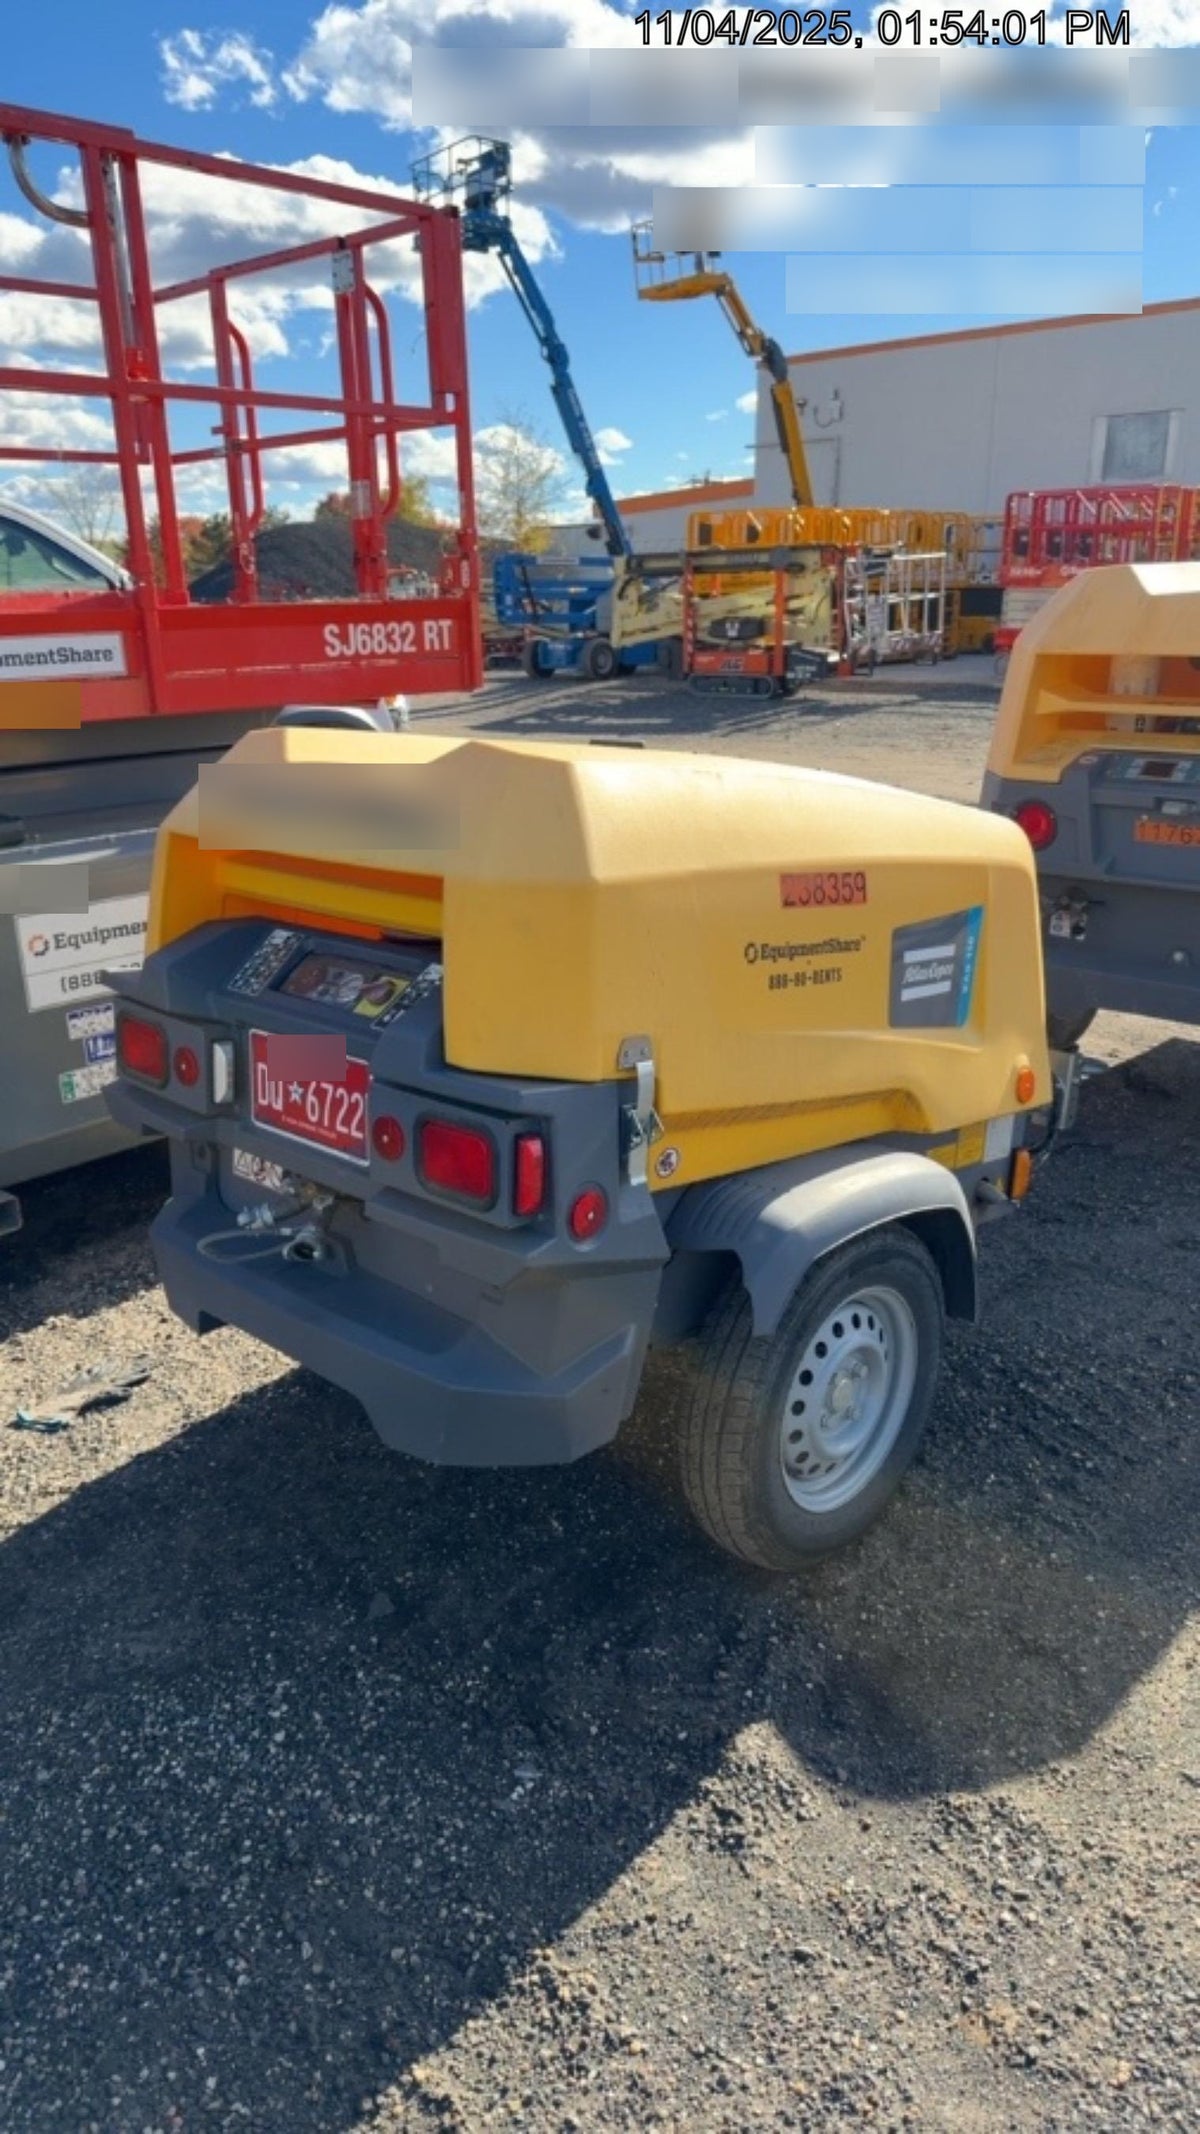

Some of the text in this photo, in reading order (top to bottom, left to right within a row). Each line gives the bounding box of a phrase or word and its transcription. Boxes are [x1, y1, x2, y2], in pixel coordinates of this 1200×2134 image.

[323, 618, 453, 657] SJ6832 RT
[0, 646, 114, 667] mentShare
